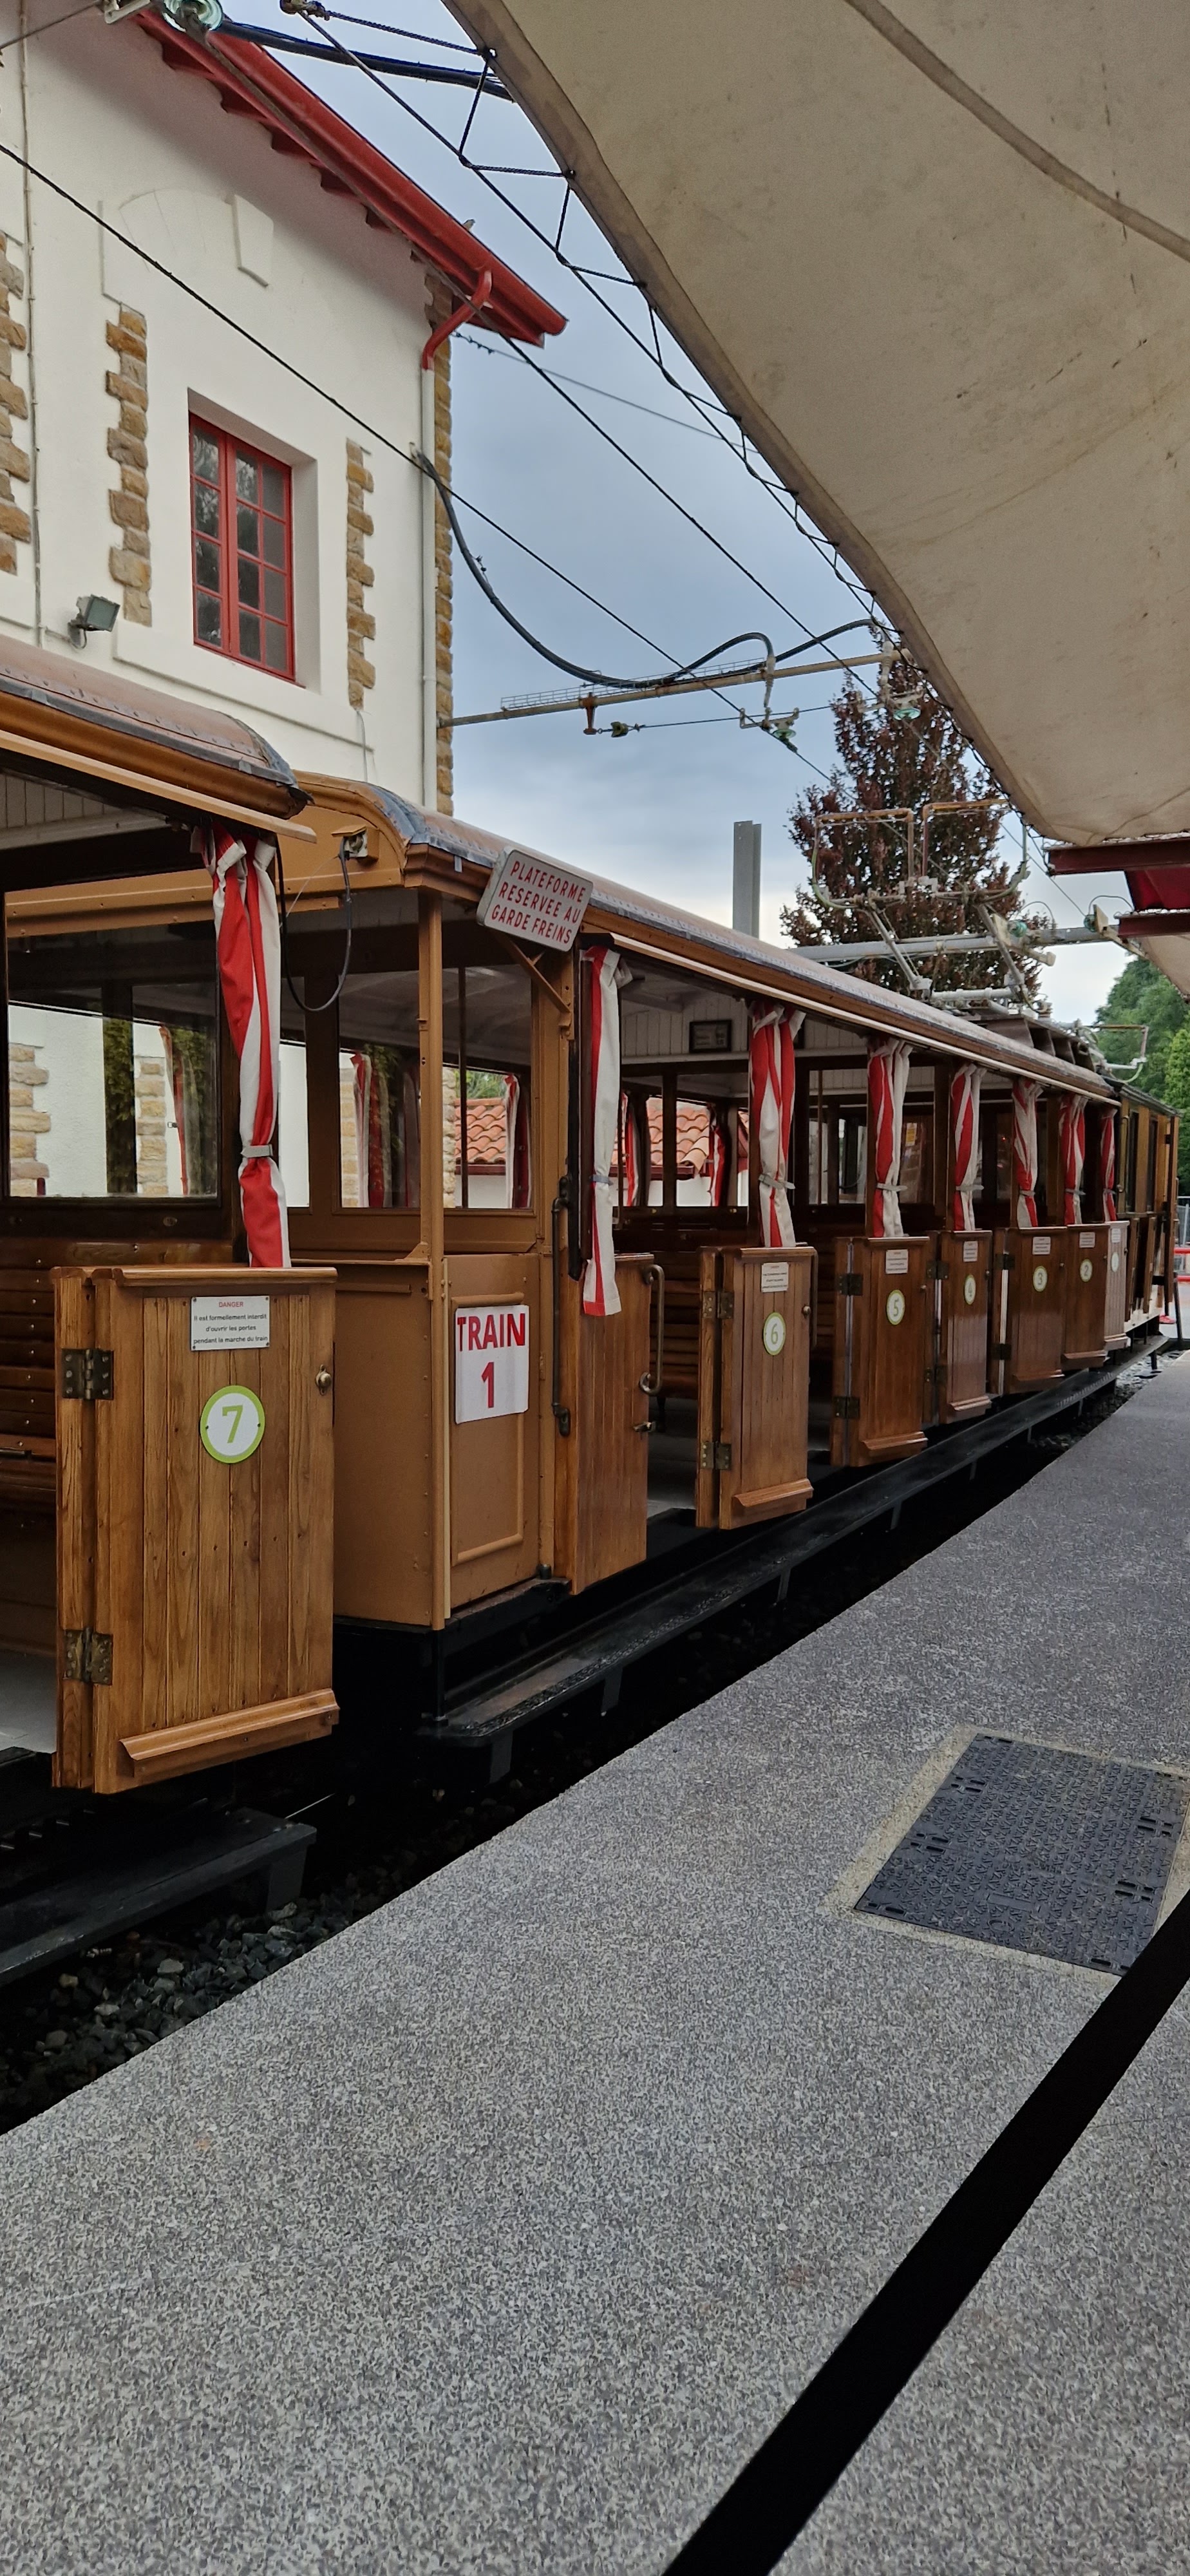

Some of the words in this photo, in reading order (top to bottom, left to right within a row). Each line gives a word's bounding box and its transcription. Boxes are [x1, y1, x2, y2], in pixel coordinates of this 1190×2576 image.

[510, 860, 586, 903] PLATEFORME
[498, 882, 562, 918] RESERVEE
[563, 906, 581, 924] AU
[491, 904, 531, 930] GARDE
[531, 917, 572, 944] FREINS
[1037, 1272, 1043, 1285] 3
[1084, 1264, 1089, 1276] 2
[893, 1297, 900, 1317] 5
[457, 1313, 525, 1352] TRAIN
[771, 1323, 778, 1345] 6
[481, 1361, 494, 1408] 1
[222, 1405, 243, 1444] 7
